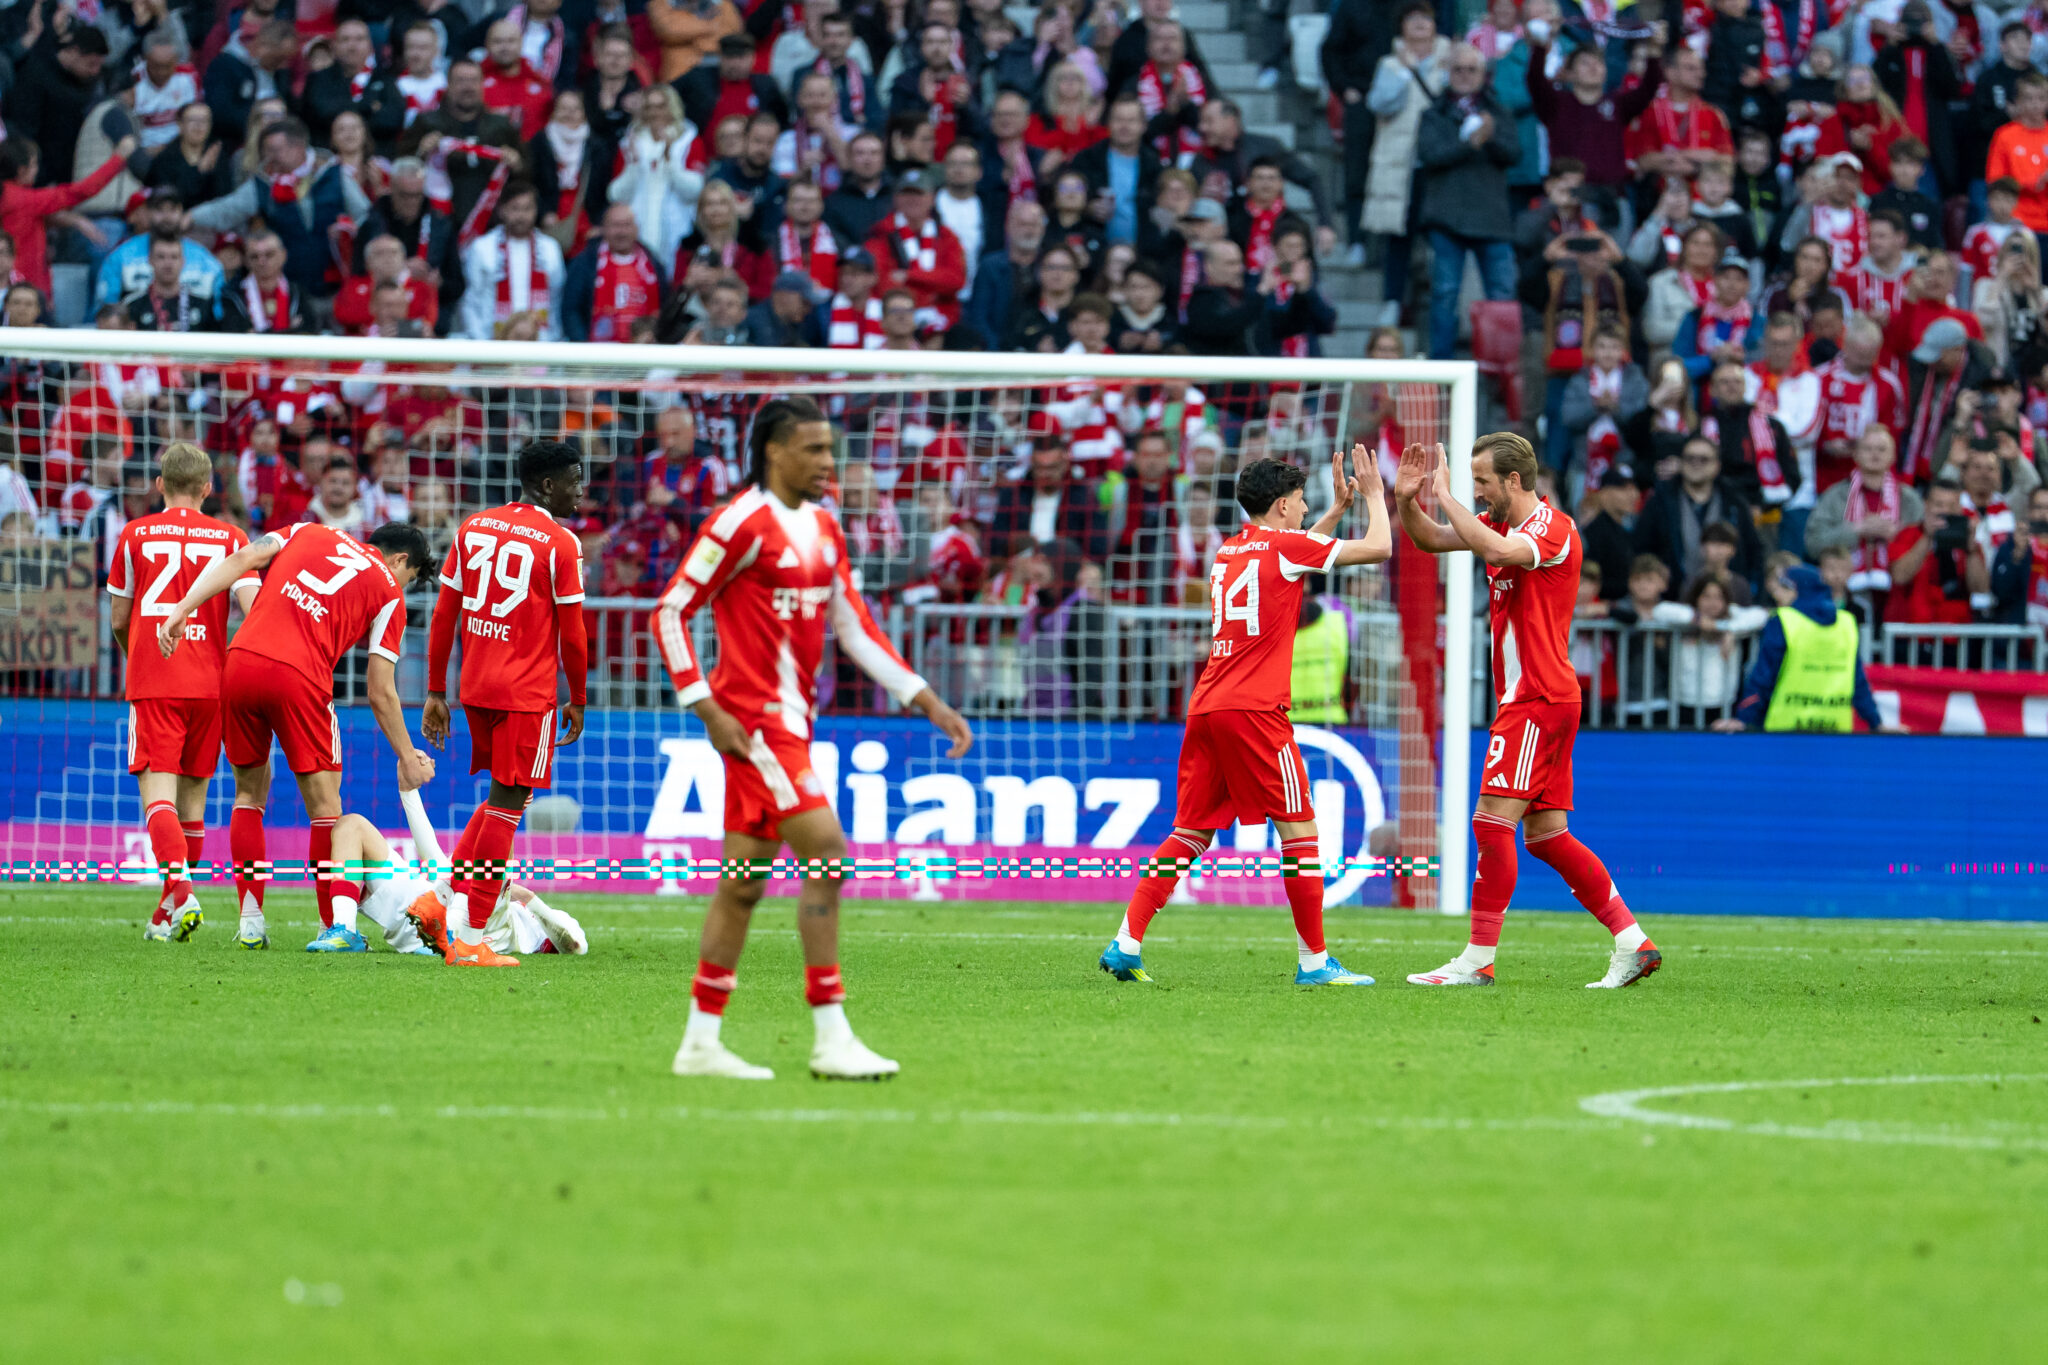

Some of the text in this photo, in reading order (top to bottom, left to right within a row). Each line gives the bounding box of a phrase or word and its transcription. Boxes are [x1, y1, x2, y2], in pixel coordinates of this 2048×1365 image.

[134, 526, 148, 537] FC
[149, 525, 186, 536] BAYERN
[480, 517, 510, 532] BAYERN
[140, 540, 226, 618] 27
[296, 542, 373, 596] 3
[462, 531, 535, 619] 39
[280, 580, 329, 624] MINJAE
[466, 616, 512, 642] NDIAYE
[1486, 735, 1506, 769] 9
[644, 737, 1161, 849] Alianz
